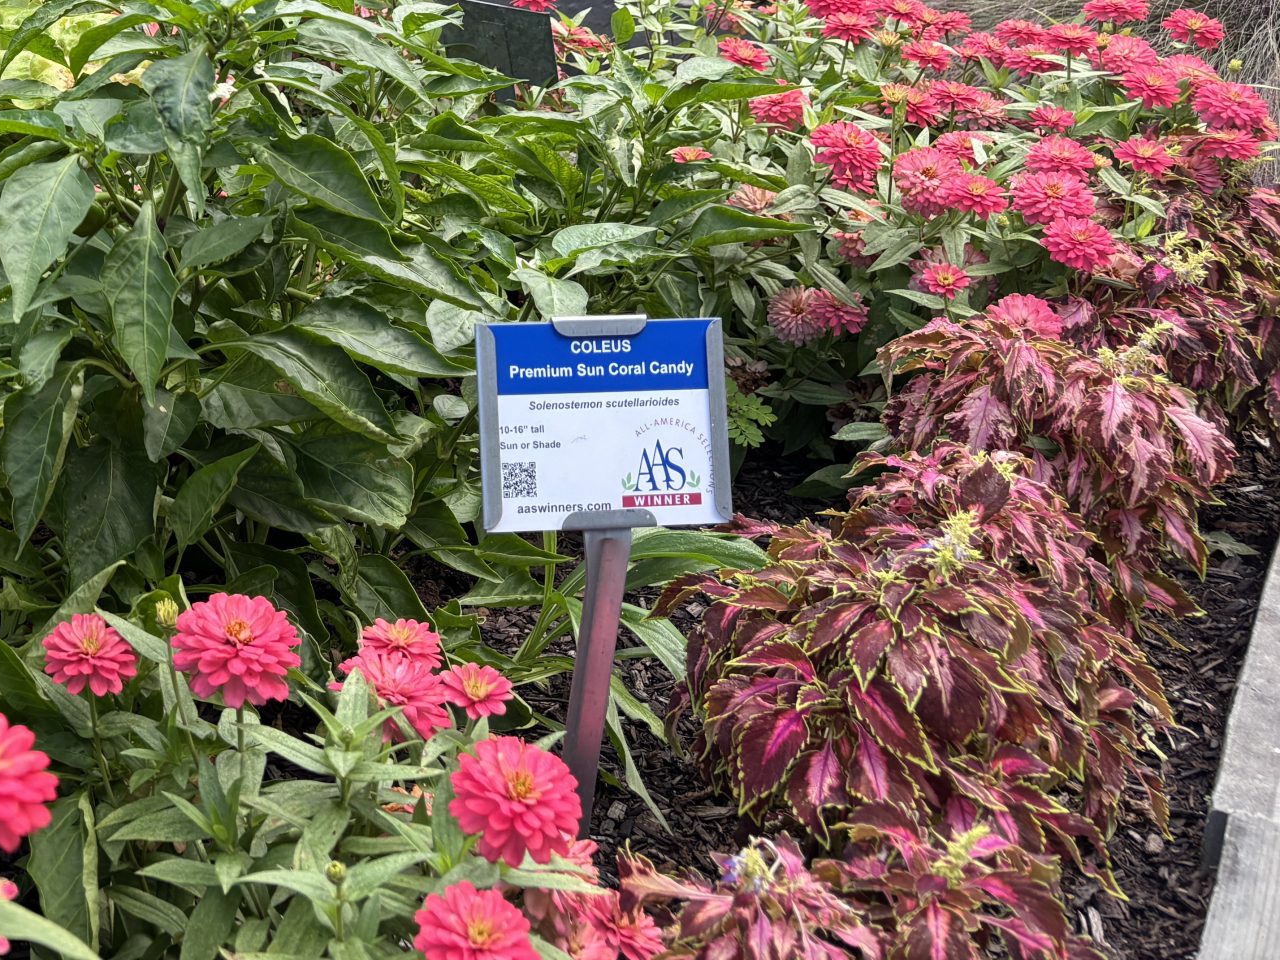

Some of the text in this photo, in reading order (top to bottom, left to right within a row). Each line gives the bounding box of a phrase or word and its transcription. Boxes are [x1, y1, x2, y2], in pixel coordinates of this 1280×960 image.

[570, 340, 631, 354] COLEUS
[509, 360, 694, 378] Premium Sun Coral Candy
[529, 397, 680, 411] Solenostemon scutellarioides
[530, 424, 545, 433] tall
[635, 417, 696, 437] ALL-AMERICA
[500, 440, 561, 450] Sun or Shade
[632, 438, 687, 492] AAS
[633, 494, 691, 506] WINNER
[517, 502, 612, 514] aaswinners.com
